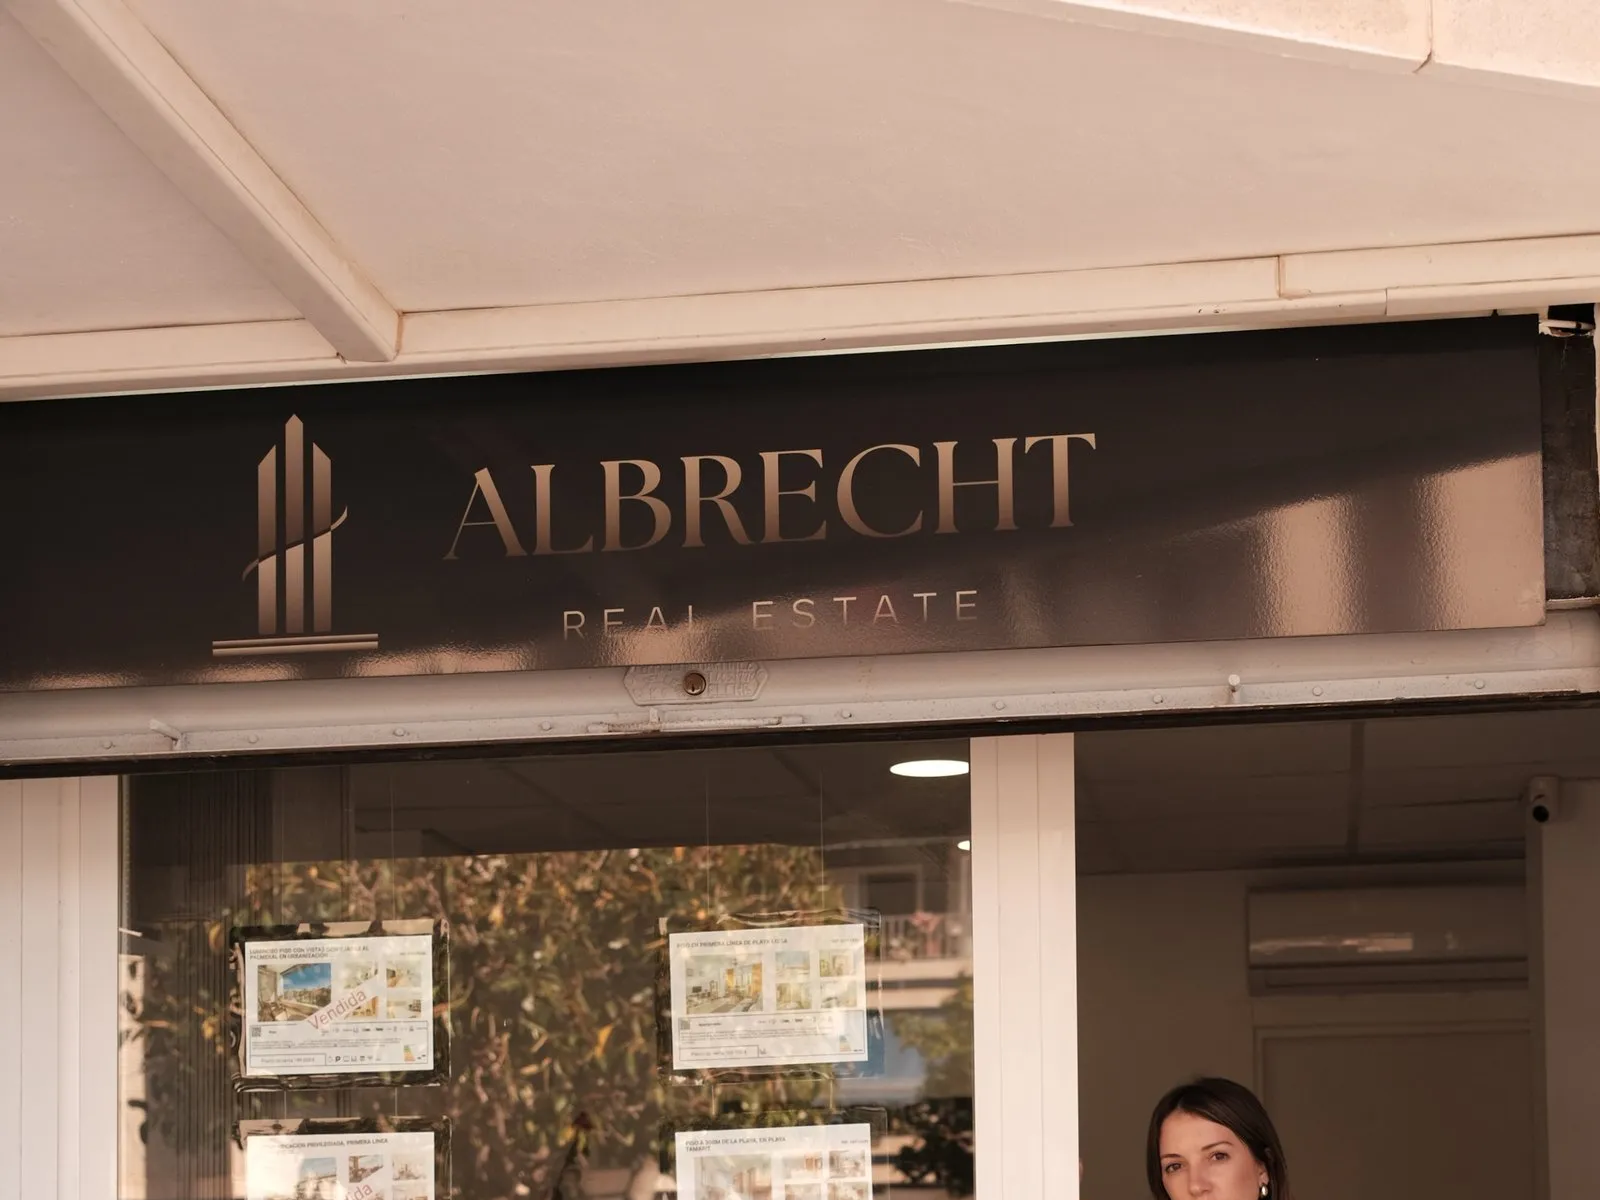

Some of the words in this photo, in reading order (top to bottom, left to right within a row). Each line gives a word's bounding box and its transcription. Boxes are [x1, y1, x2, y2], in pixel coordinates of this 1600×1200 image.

[443, 432, 1097, 560] ALBRECHT
[752, 590, 978, 632] ESTATE
[308, 989, 367, 1030] Vendida
